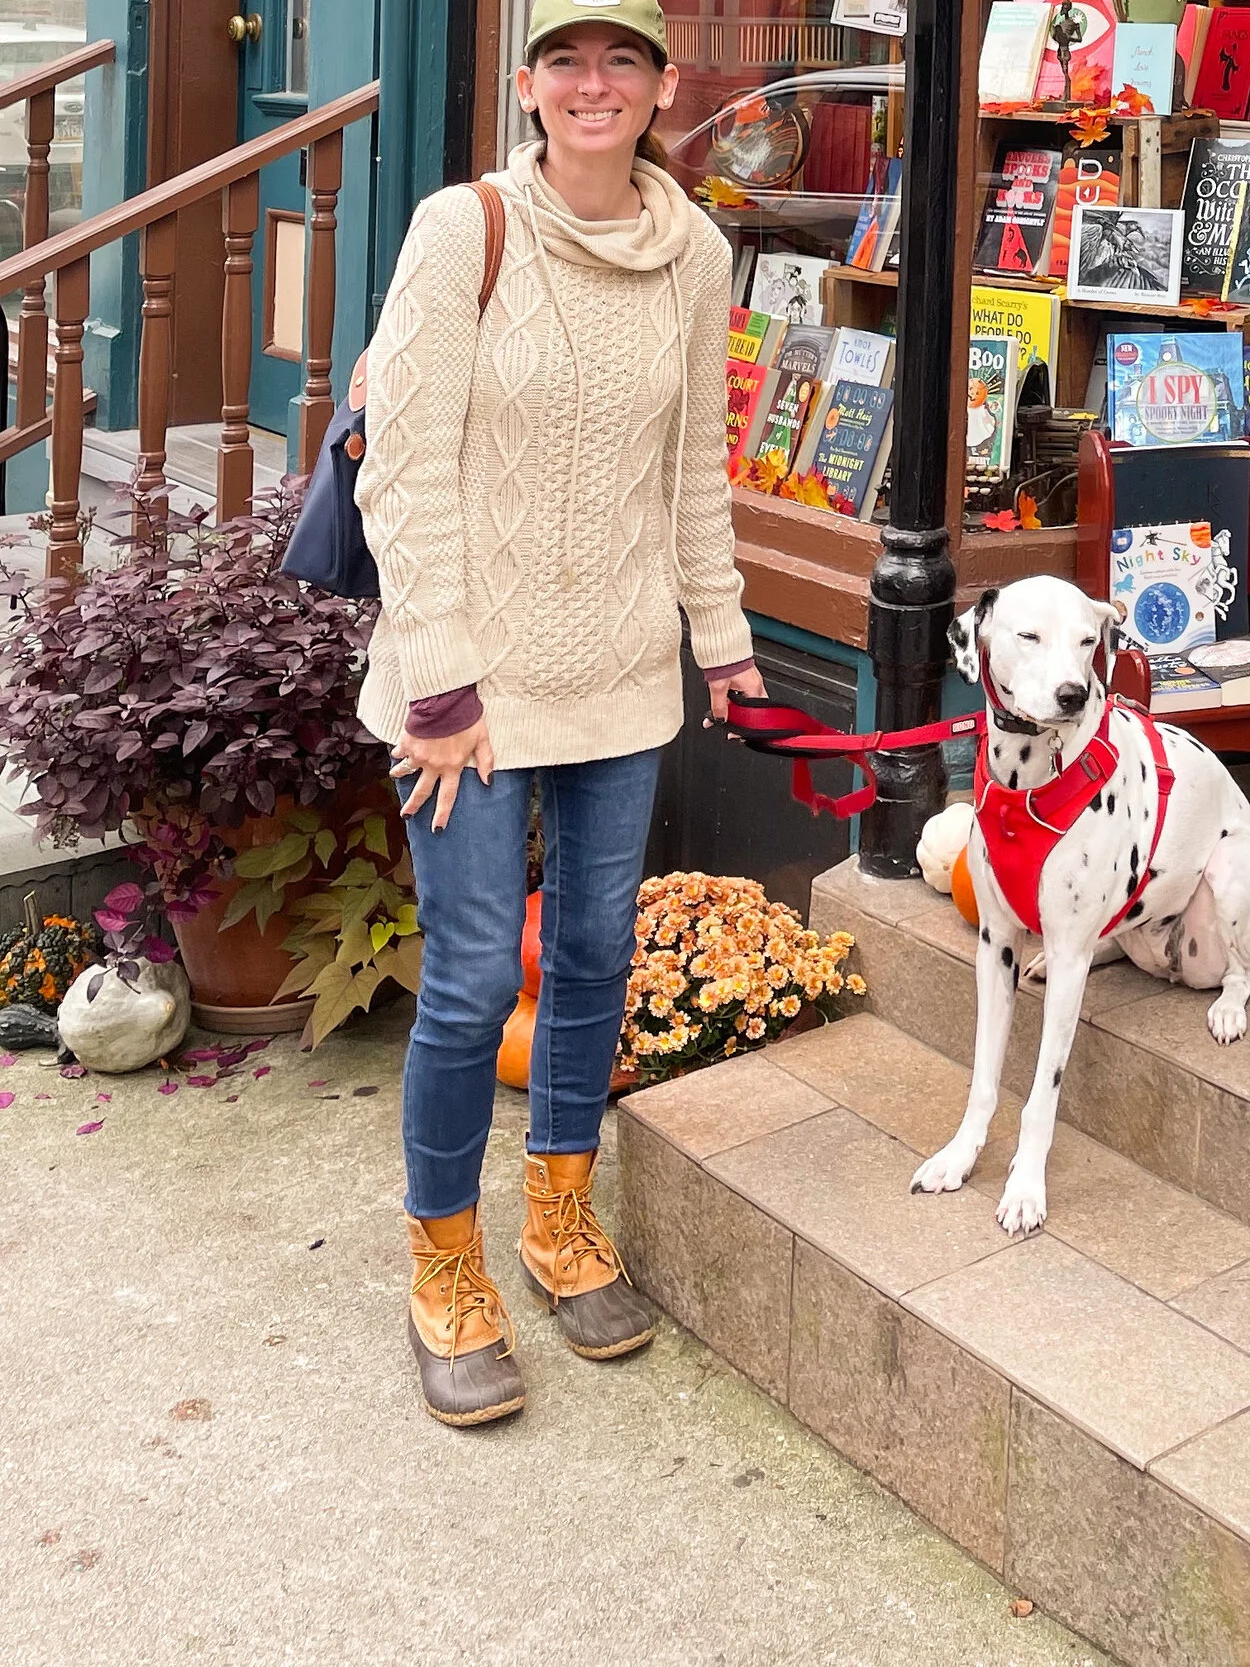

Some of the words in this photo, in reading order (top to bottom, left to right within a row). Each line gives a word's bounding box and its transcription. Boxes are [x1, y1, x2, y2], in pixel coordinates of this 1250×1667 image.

[1002, 163, 1050, 180] SPOOKS
[996, 297, 1028, 311] Scarry's
[972, 308, 1005, 325] WHAT
[1006, 312, 1024, 327] DO
[1015, 330, 1032, 345] DO
[838, 341, 881, 373] TOWLES
[780, 359, 818, 375] MARVELS
[727, 375, 760, 393] COURT
[1150, 375, 1157, 405] I
[1165, 374, 1203, 405] SPY
[776, 399, 800, 413] SEVEN
[838, 402, 856, 419] Matt
[855, 407, 873, 427] Haig
[1144, 405, 1179, 421] SPOOKY
[1179, 405, 1208, 421] NIGHT
[766, 412, 801, 430] HUSBANDS
[828, 453, 865, 471] MIDNIGHT
[822, 465, 853, 483] LIBRARY
[1116, 548, 1166, 573] Night
[1172, 546, 1201, 566] Sky
